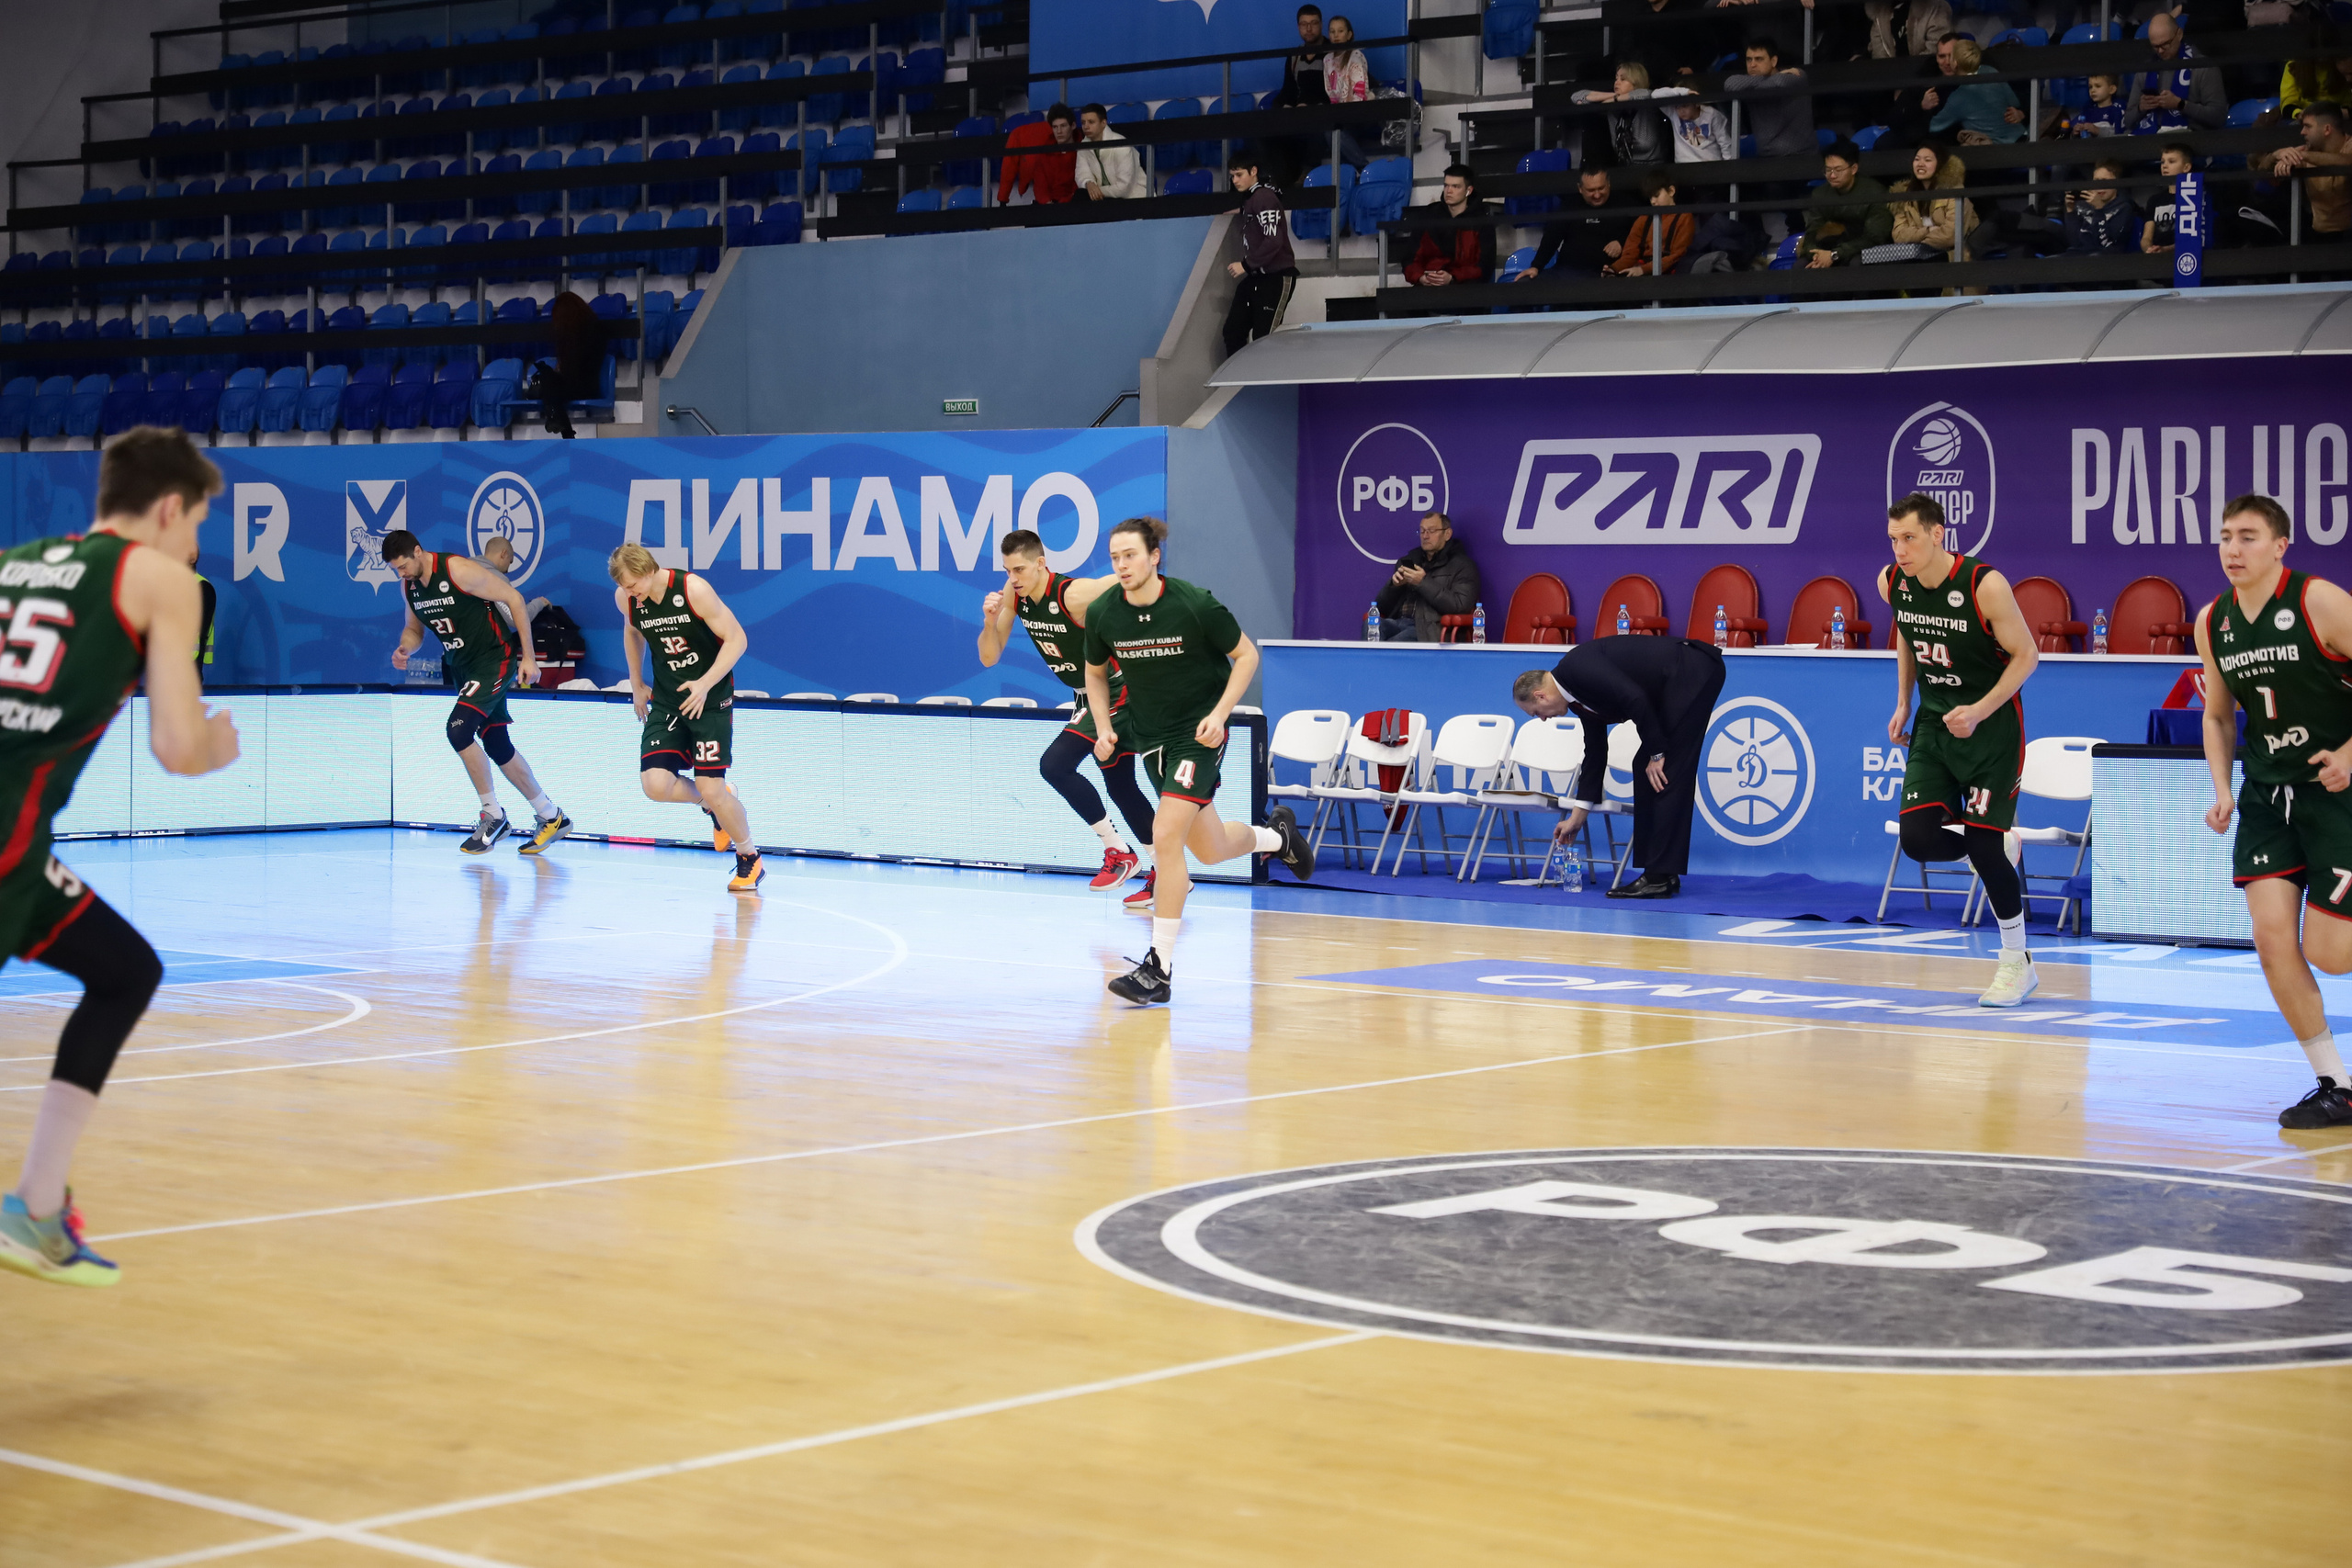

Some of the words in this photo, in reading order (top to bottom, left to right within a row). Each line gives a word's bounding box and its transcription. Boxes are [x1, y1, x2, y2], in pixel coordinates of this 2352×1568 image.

[945, 402, 973, 412] ВЫХОД
[1918, 471, 1962, 484] PARI
[2072, 426, 2225, 545] PARI
[1353, 476, 1434, 512] РФБ
[1516, 448, 1804, 531] PARI
[621, 471, 1100, 573] ДИНАМО
[430, 617, 456, 635] 27
[640, 614, 691, 630] ЛОКОМОТИВ
[1897, 609, 1968, 633] ЛОКОМОТИВ
[1913, 626, 1947, 637] КУБАНЬ
[660, 636, 690, 655] 32
[1035, 639, 1063, 659] 18
[1114, 638, 1156, 648] LOKOMOTIV
[1156, 636, 1182, 645] KUBAN
[1115, 646, 1184, 659] BASKETBALL
[1913, 640, 1953, 668] 24
[2219, 644, 2300, 673] ЛОКОМОТИВ
[2237, 665, 2276, 680] КУБАНЬ
[695, 740, 720, 762] 32
[1173, 759, 1196, 789] 4
[1966, 786, 1992, 817] 24
[2329, 867, 2352, 905] 7
[1365, 1179, 2352, 1311] РФБ
